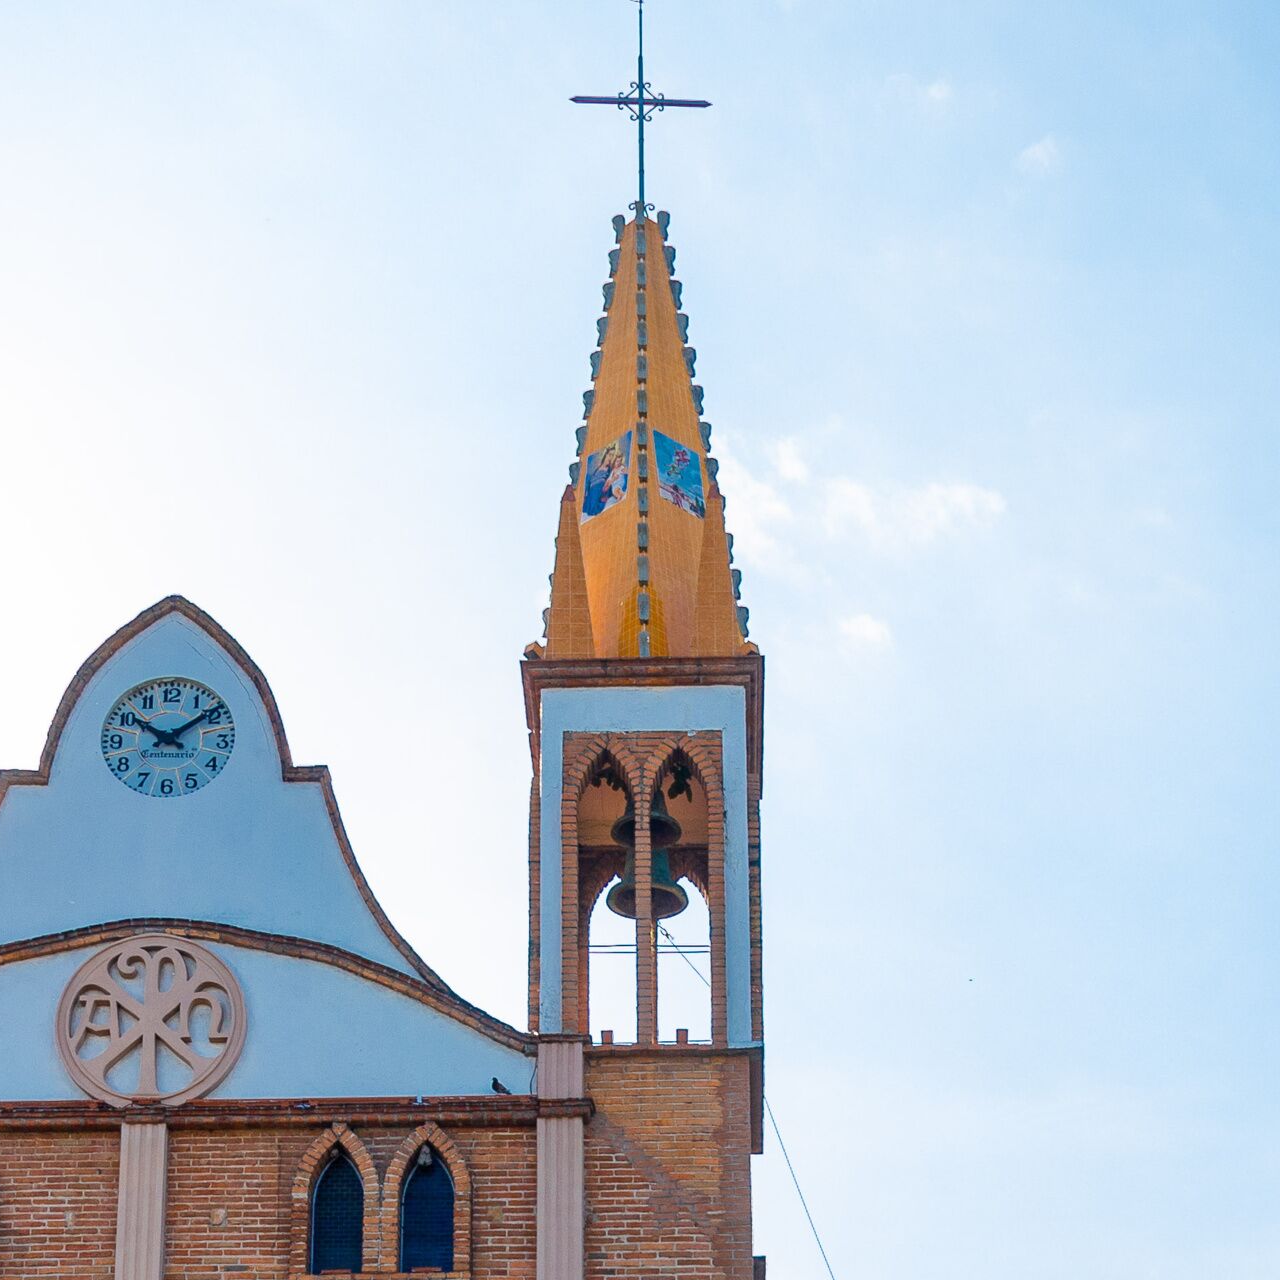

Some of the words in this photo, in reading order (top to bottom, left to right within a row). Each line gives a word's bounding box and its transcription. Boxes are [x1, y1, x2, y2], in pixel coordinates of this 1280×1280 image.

[142, 695, 154, 710] 11
[163, 688, 181, 703] 12
[193, 695, 200, 709] 1
[120, 712, 136, 727] 10
[110, 734, 123, 749] 9
[217, 733, 229, 748] 3
[117, 757, 130, 772] 8
[205, 756, 218, 771] 4
[137, 772, 150, 787] 7
[161, 778, 173, 794] 6
[185, 773, 198, 788] 5
